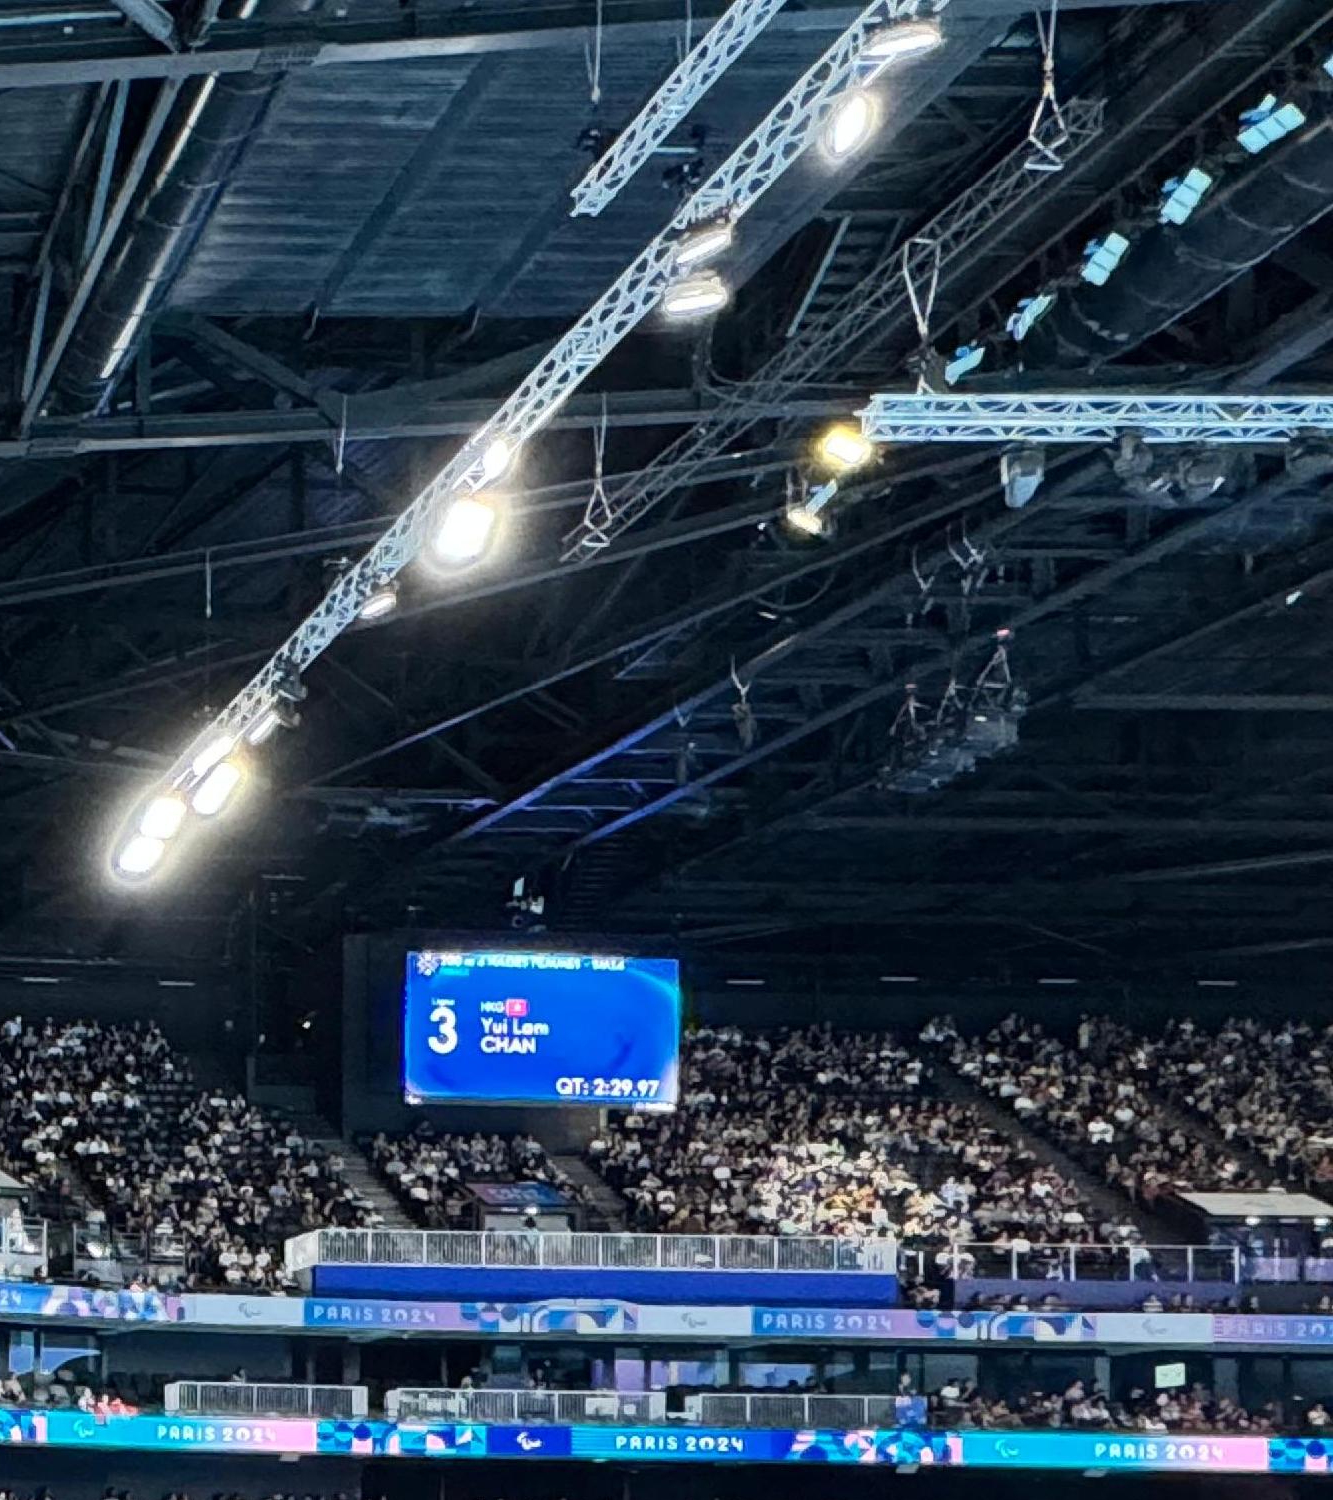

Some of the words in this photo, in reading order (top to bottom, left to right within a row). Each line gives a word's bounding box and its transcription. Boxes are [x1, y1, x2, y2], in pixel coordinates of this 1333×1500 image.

[428, 1008, 458, 1054] 3
[481, 1018, 507, 1035] Yui
[481, 1037, 536, 1054] CHAN
[594, 1078, 660, 1097] 2:29.97
[314, 1305, 374, 1322] PARIS
[381, 1308, 435, 1323] 2024
[763, 1314, 824, 1330] PARIS
[834, 1317, 890, 1331] 2024
[158, 1424, 214, 1440] PARIS
[222, 1427, 276, 1443] 2024
[615, 1435, 678, 1453] PARIS
[685, 1436, 744, 1453] 2024
[1094, 1441, 1158, 1461] PARIS
[1165, 1445, 1225, 1461] 2024
